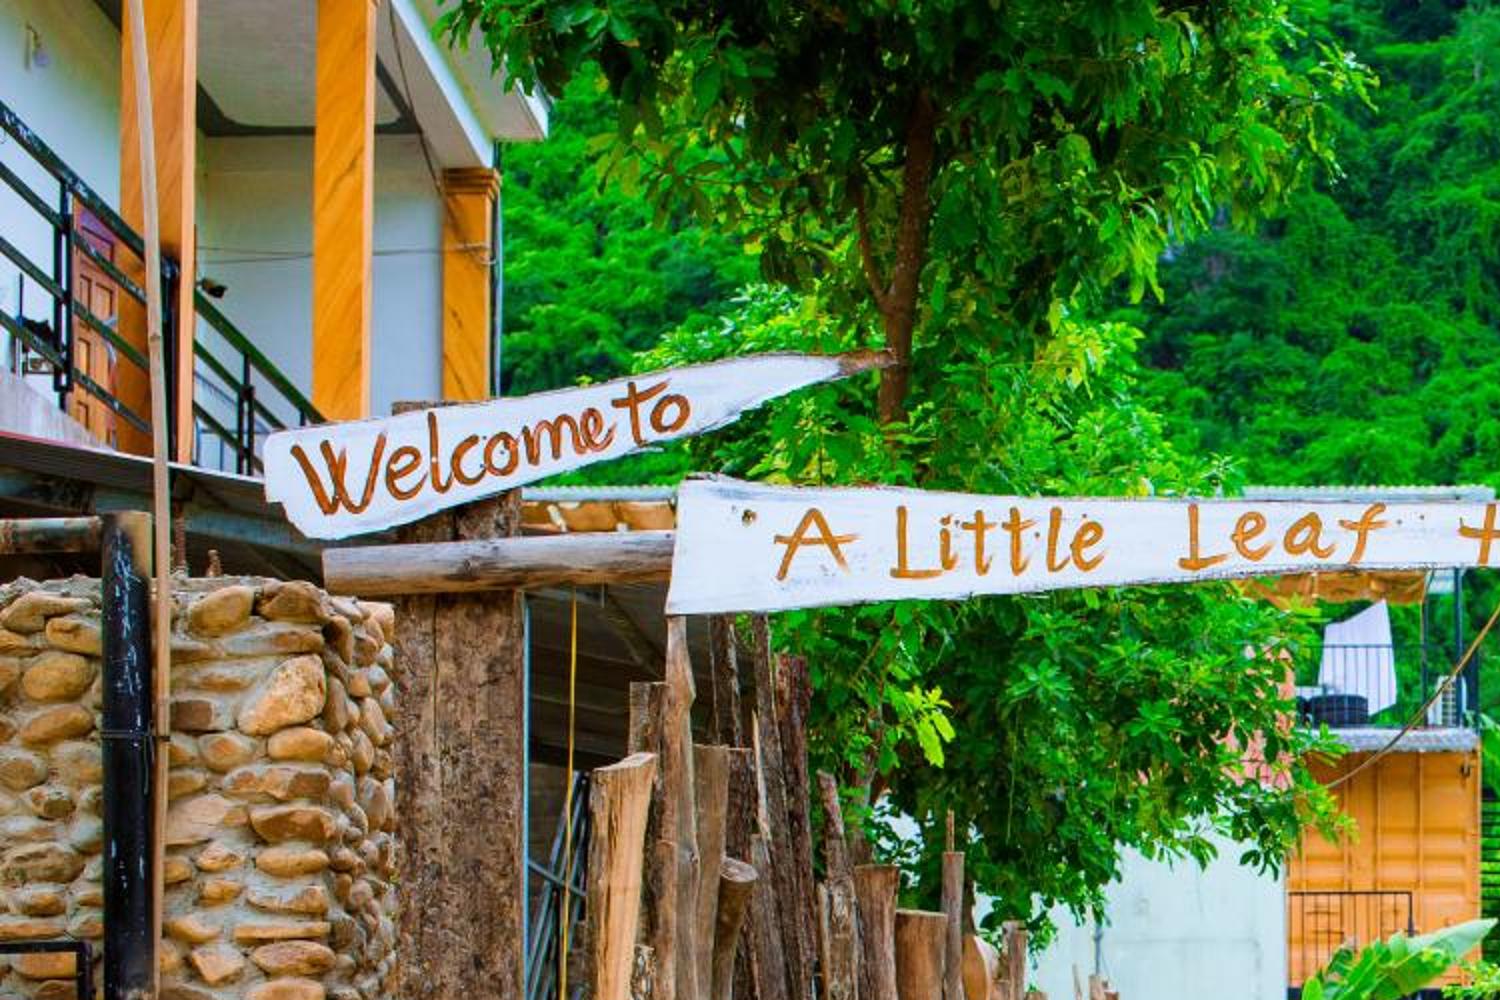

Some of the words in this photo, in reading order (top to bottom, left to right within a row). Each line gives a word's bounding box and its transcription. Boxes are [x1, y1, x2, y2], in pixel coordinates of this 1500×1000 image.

[292, 410, 612, 514] Welcome
[612, 380, 690, 446] to
[774, 507, 862, 580] A
[890, 504, 1105, 578] Little
[1178, 503, 1388, 569] Leaf
